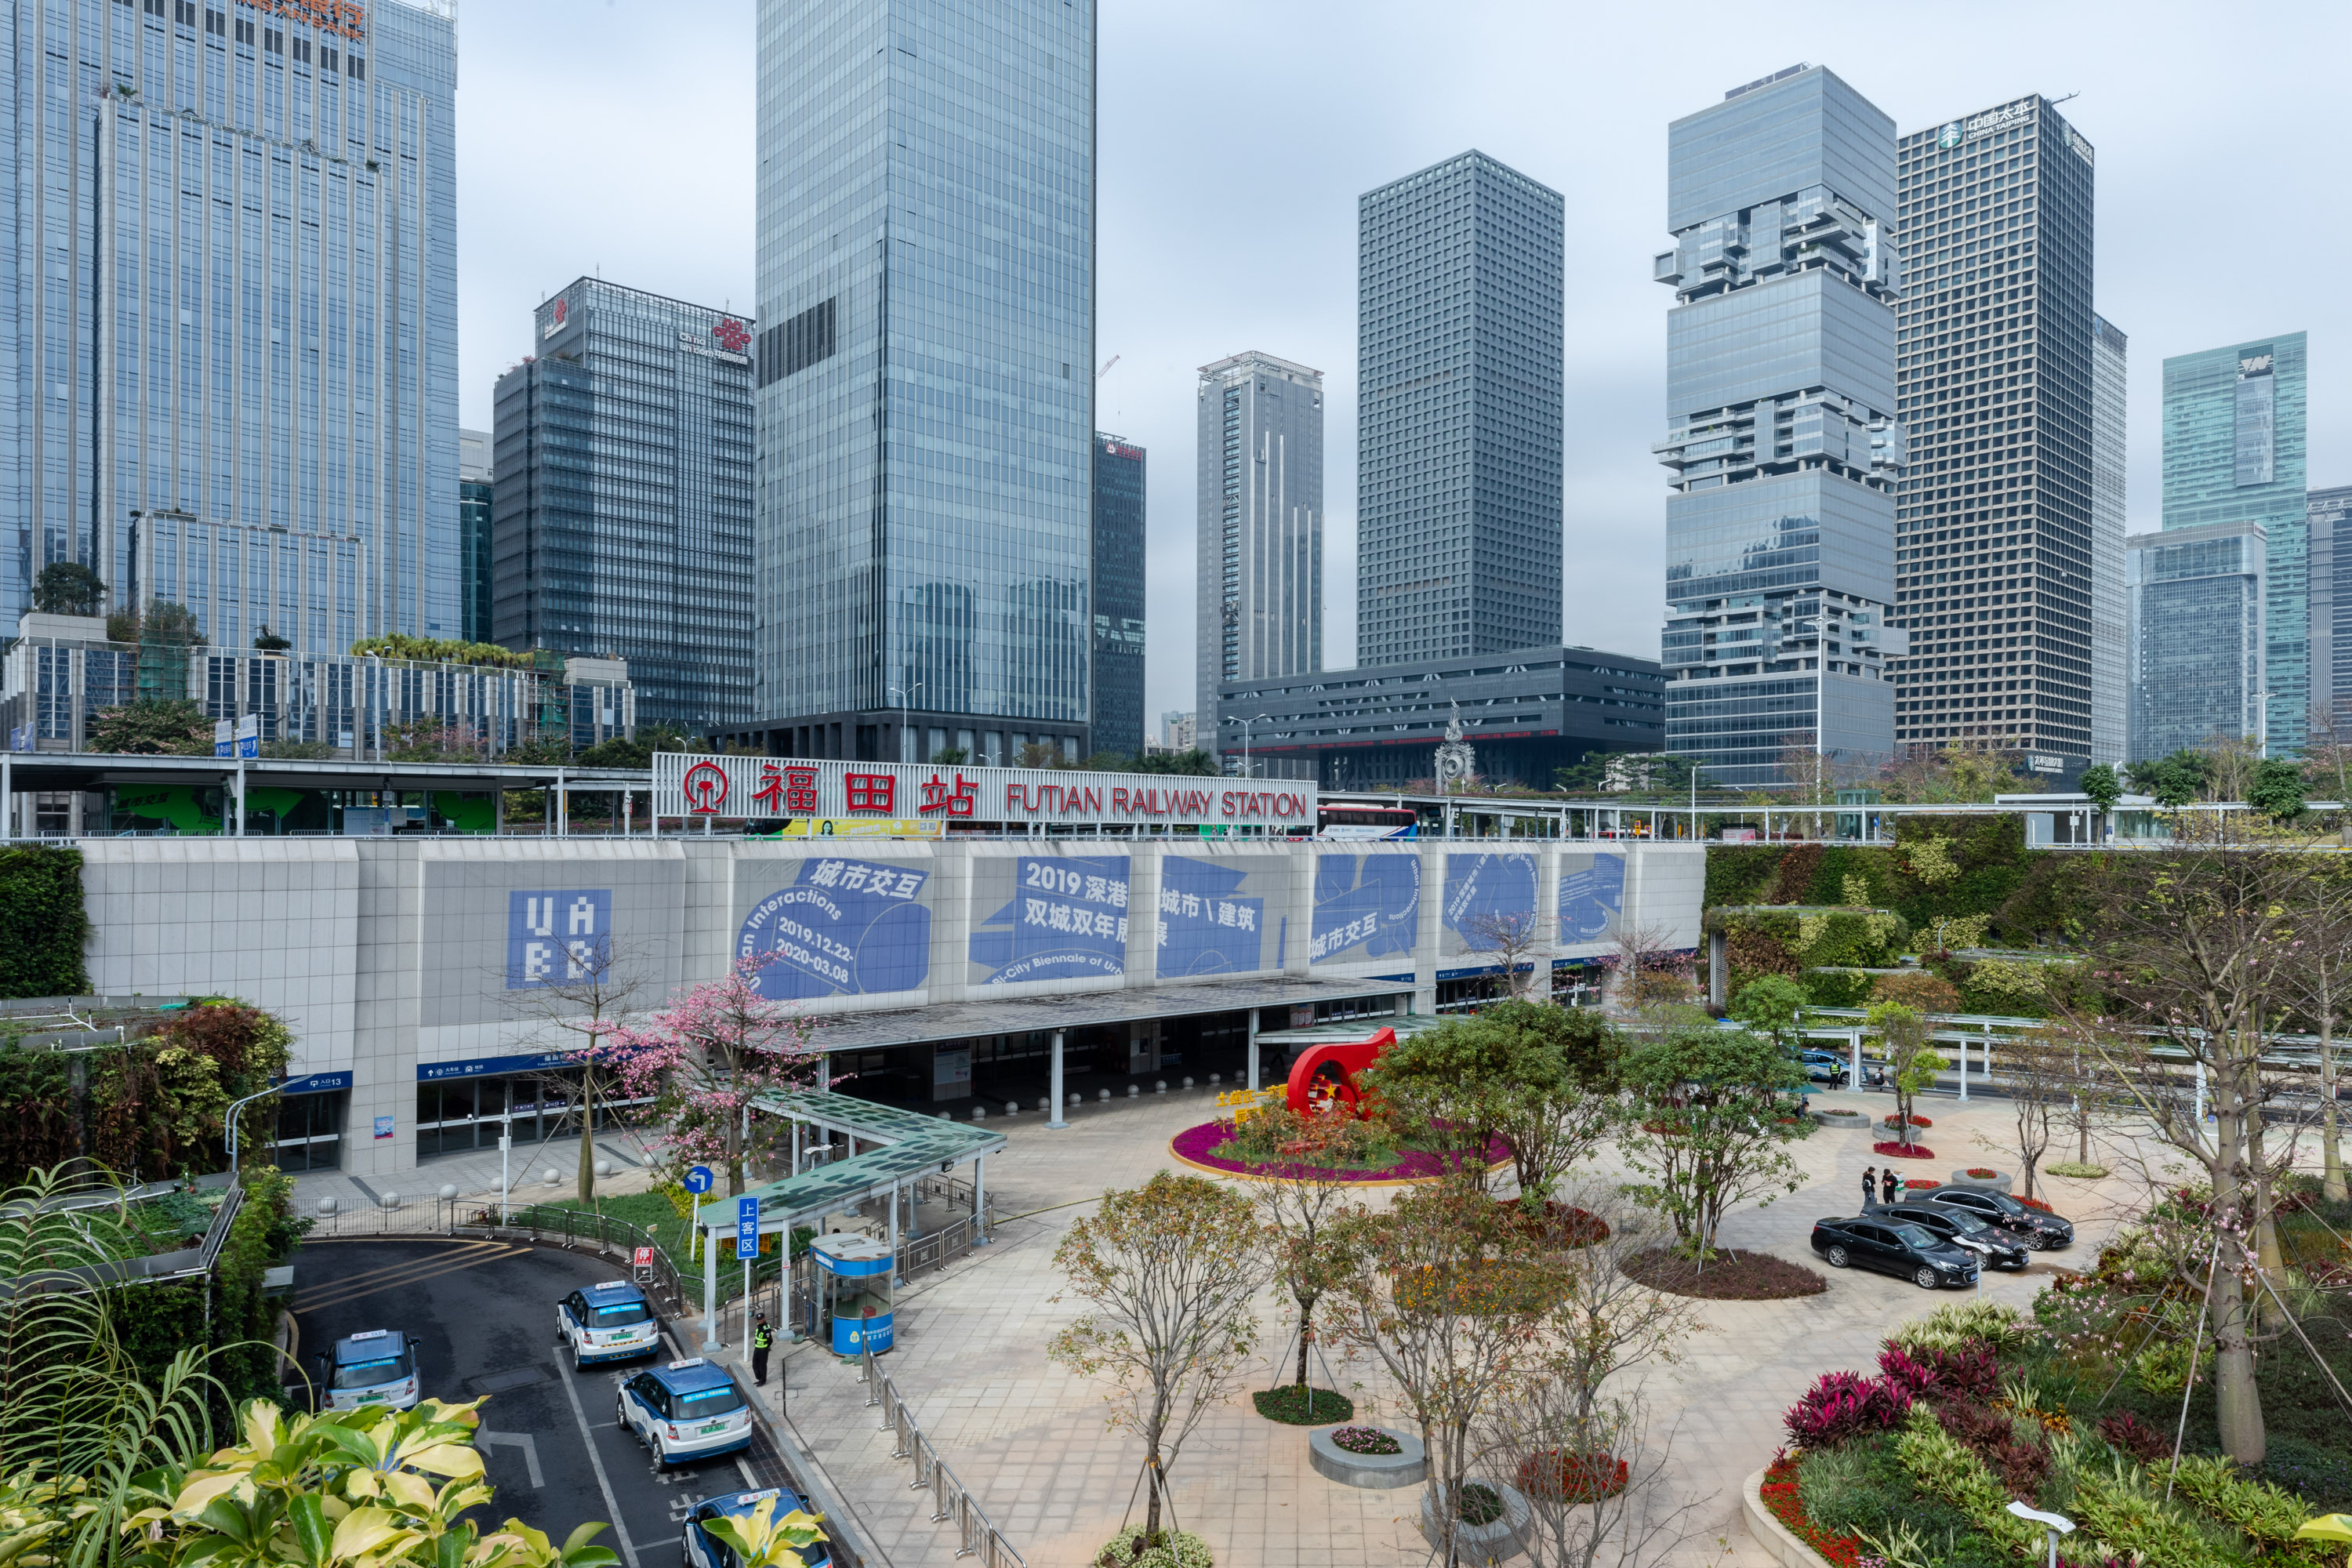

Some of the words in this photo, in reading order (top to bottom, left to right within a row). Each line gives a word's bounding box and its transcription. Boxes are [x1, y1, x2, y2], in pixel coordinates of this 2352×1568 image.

[312, 16, 364, 42] BANK
[1968, 102, 2030, 132] 中国太平
[1968, 127, 1994, 140] CHINA
[1995, 114, 2030, 132] TAIPING
[679, 332, 706, 346] China
[680, 343, 715, 358] unicom
[714, 350, 749, 365] 中国联通
[751, 763, 979, 818] 福田站
[1007, 782, 1102, 814] FUTIAN
[1112, 786, 1214, 815] RAILWAY
[1221, 791, 1307, 817] STATION
[809, 858, 924, 900] 城市交互
[1025, 862, 1081, 895] 2019
[1085, 875, 1128, 908] 深港
[1411, 858, 1420, 886] Urban
[746, 889, 842, 930] Interactions
[1388, 888, 1420, 920] Interactions
[778, 916, 854, 962] 2019.12.22-
[1310, 912, 1377, 960] 城市交互
[775, 938, 849, 984] 2020-03.08
[1032, 953, 1087, 968] Biennale
[1089, 958, 1103, 967] of
[741, 1203, 755, 1252] 上客区
[639, 1248, 650, 1260] 停
